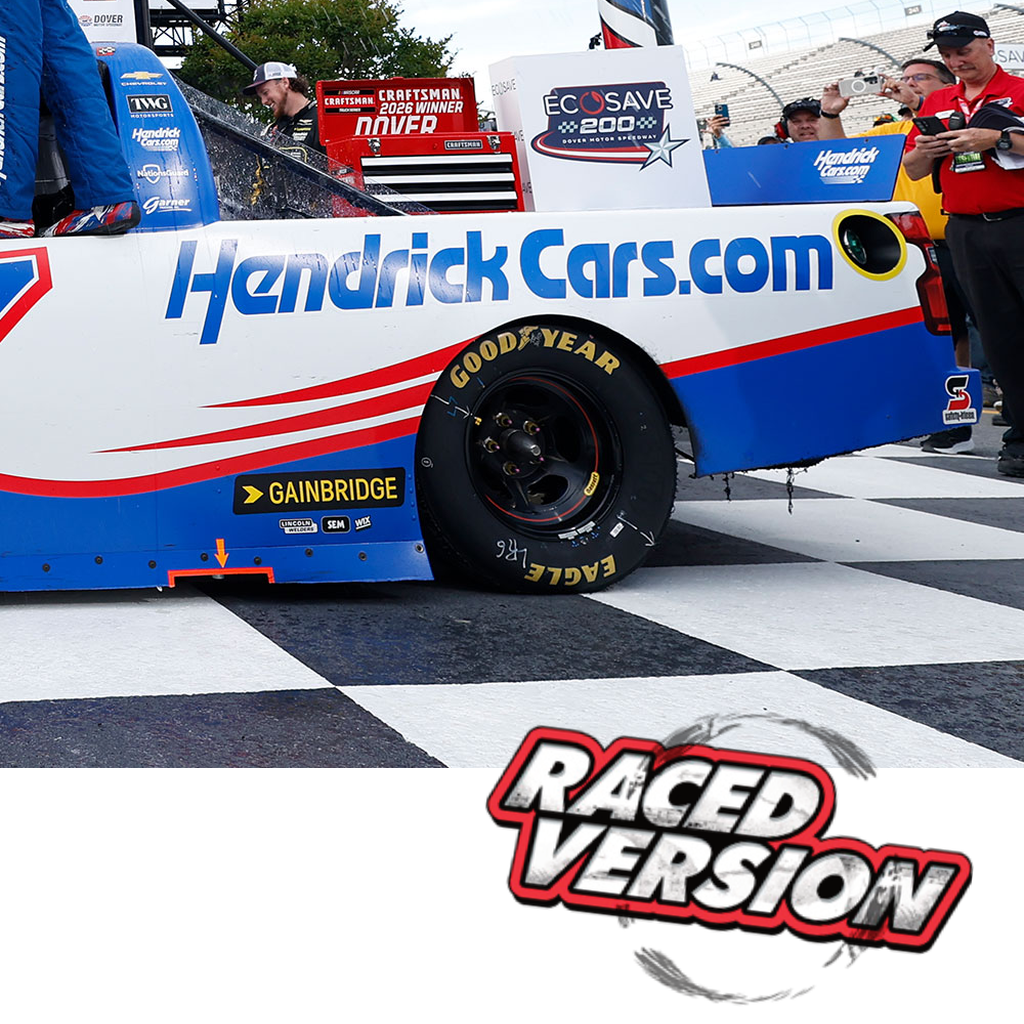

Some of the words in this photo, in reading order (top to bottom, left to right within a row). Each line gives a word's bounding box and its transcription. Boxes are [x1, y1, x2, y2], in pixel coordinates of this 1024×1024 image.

[94, 15, 123, 23] DOVER
[324, 97, 375, 106] CRAFTSMAN
[379, 88, 461, 102] CRAFTSMAN
[546, 88, 673, 116] ECOSAVE
[131, 97, 168, 110] TWG
[380, 102, 413, 115] 2026
[415, 101, 464, 114] WINNER
[354, 115, 438, 135] DOVER
[579, 115, 636, 133] 200
[132, 127, 181, 142] Hendrick
[617, 134, 658, 142] SPEEDWAY
[140, 138, 179, 147] Cars.com
[814, 147, 880, 169] Hendrick
[820, 163, 870, 177] Cars.com
[142, 196, 191, 215] Garner
[268, 477, 398, 504] GAINBRIDGE
[327, 520, 345, 529] SEM
[355, 516, 371, 527] WIX
[524, 555, 617, 586] EAGLE
